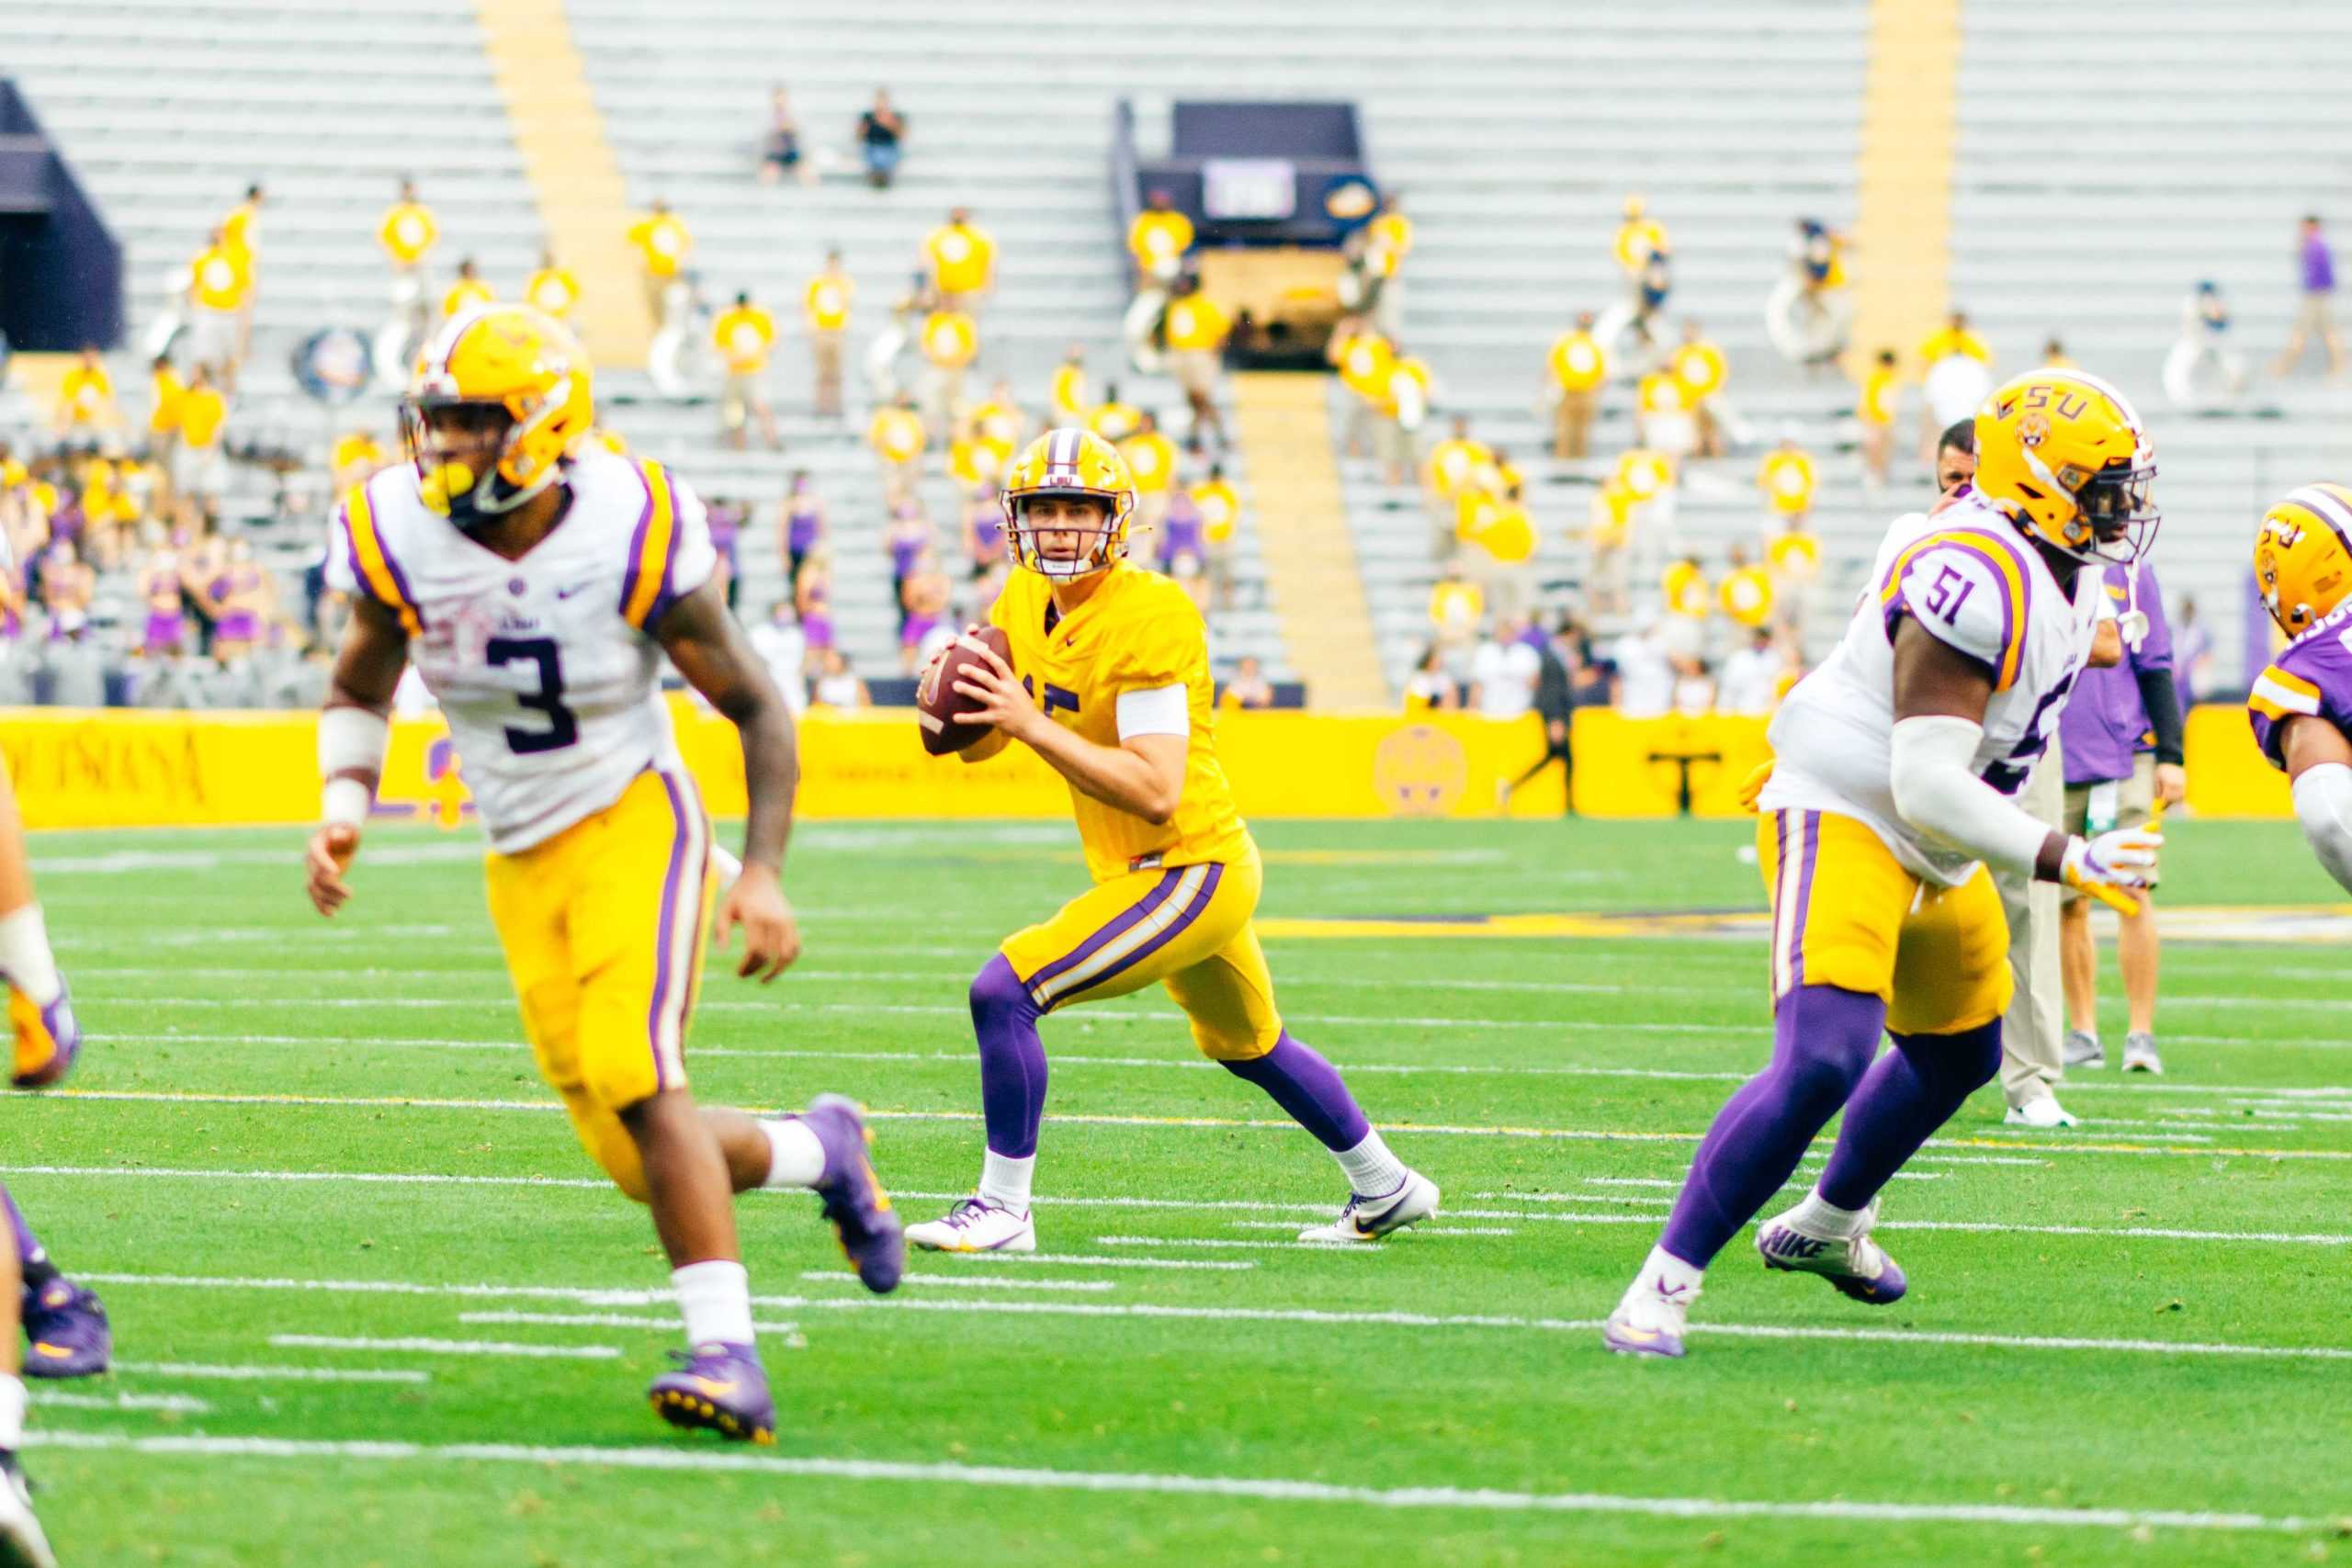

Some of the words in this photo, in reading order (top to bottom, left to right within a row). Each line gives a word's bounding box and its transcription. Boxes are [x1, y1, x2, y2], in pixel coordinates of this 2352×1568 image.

[1927, 564, 1975, 626] 51
[486, 637, 579, 754] 3
[1760, 1224, 1831, 1258] NIKE
